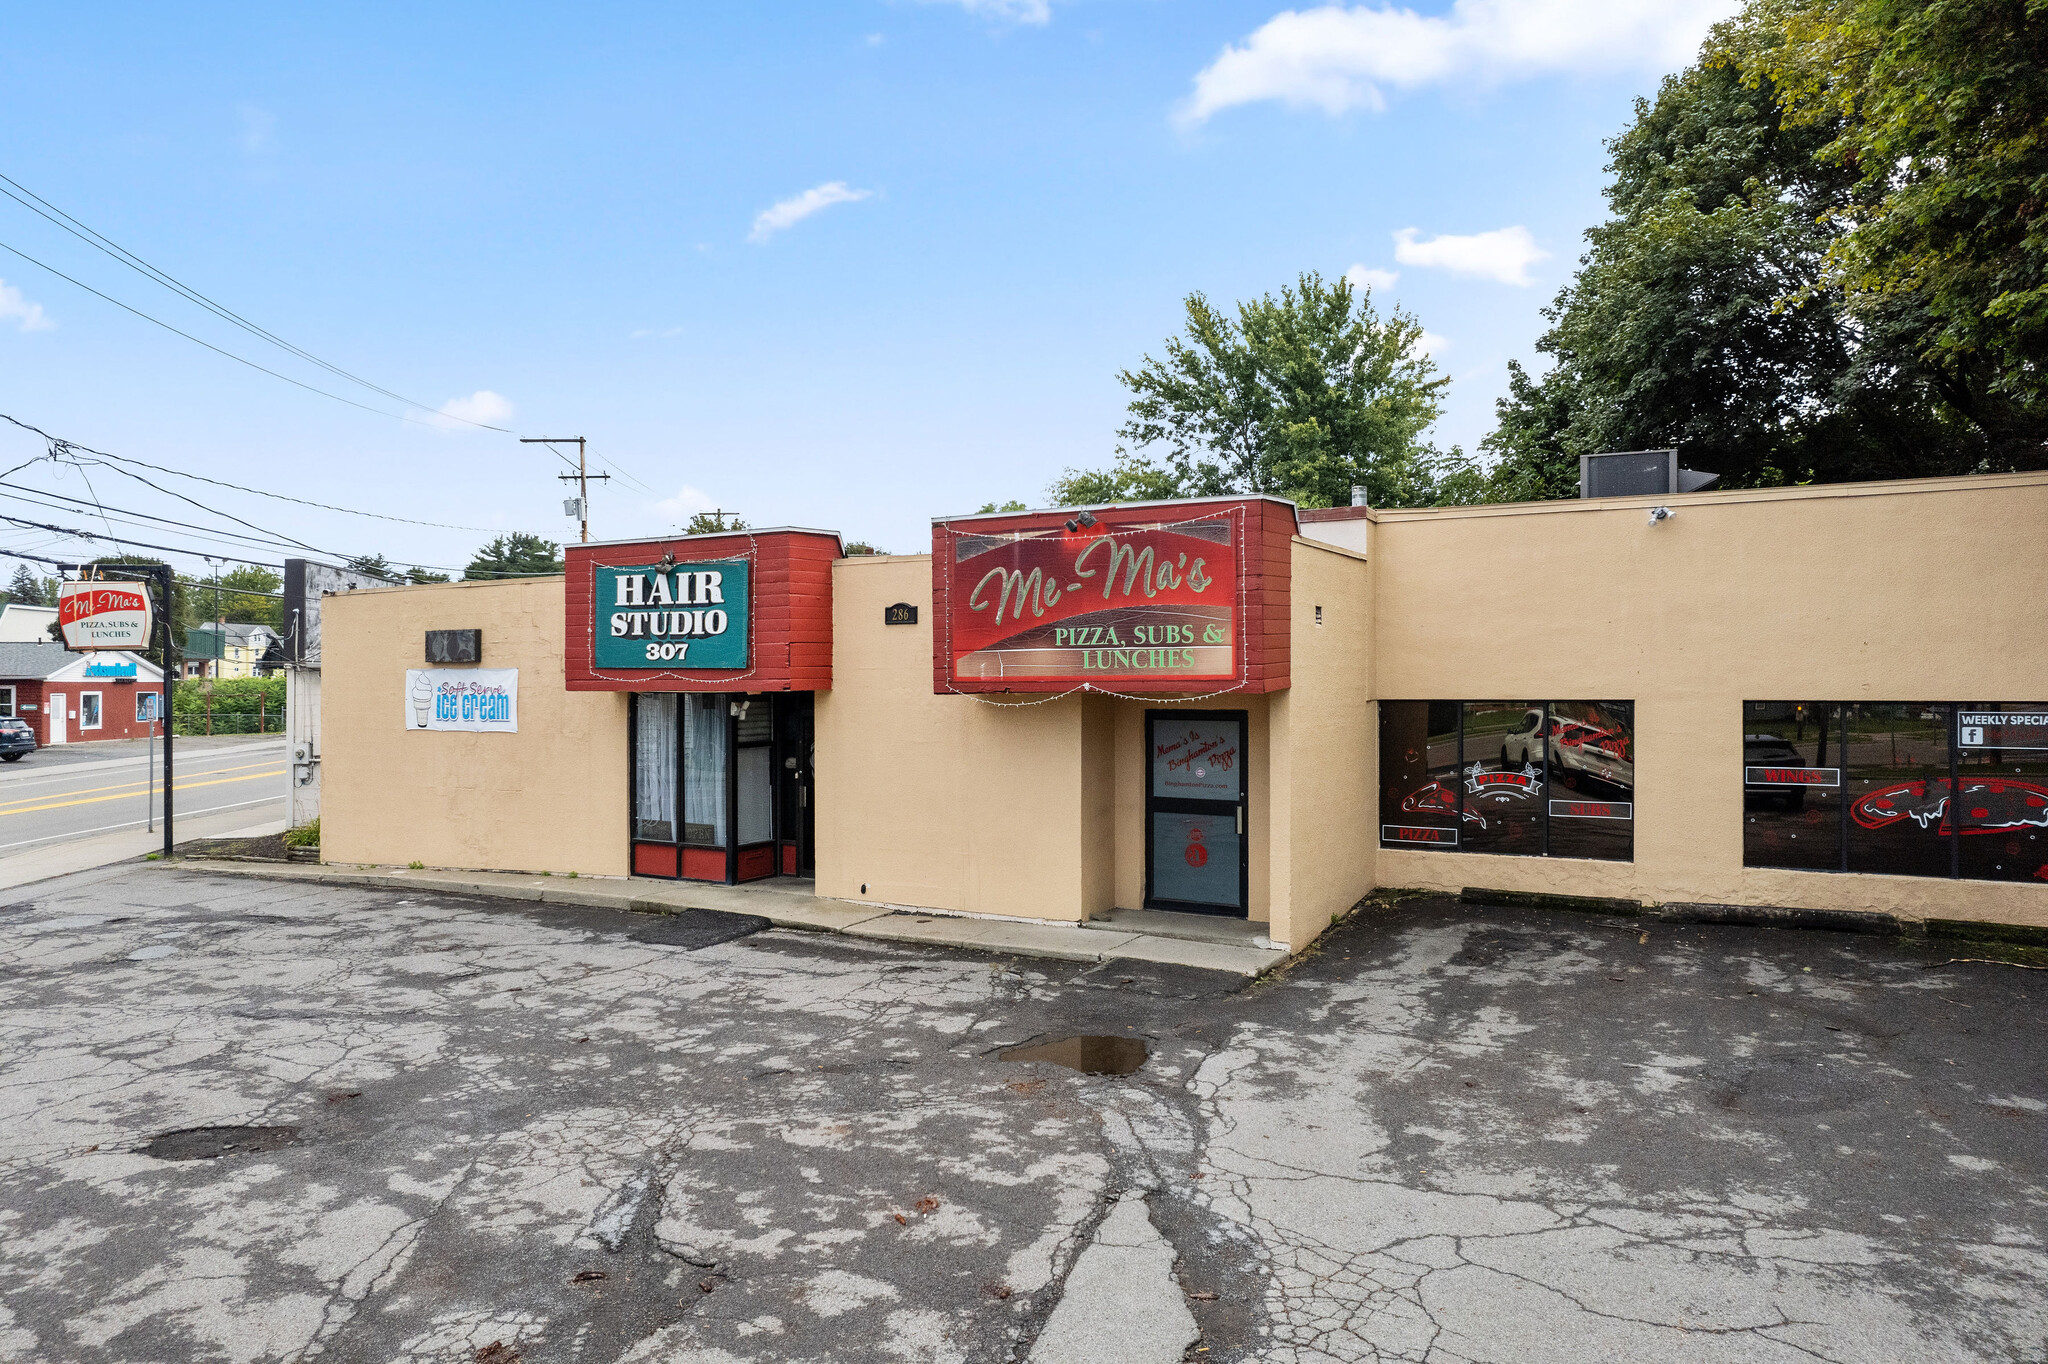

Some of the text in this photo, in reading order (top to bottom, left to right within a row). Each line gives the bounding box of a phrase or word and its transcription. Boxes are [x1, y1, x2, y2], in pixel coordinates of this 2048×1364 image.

[614, 571, 725, 606] HAIR
[969, 536, 1213, 626] Me-Ma's
[610, 609, 728, 637] STUDIO
[892, 608, 909, 621] 286
[80, 621, 107, 629] PIZZA,
[1055, 623, 1226, 648] PIZZA, SUBS &
[645, 643, 690, 661] 307
[1083, 649, 1195, 669] LUNCHES
[441, 681, 503, 699] Soft Serve
[436, 686, 510, 720] ice cream
[1961, 715, 2009, 725] WEEKLY
[1167, 735, 1226, 771] Binghamton's
[1208, 746, 1236, 772] Pizza
[1478, 773, 1527, 786] PIZZA
[1764, 769, 1822, 784] WINGS
[1570, 803, 1611, 816] SUBS
[1399, 828, 1440, 841] PIZZA
